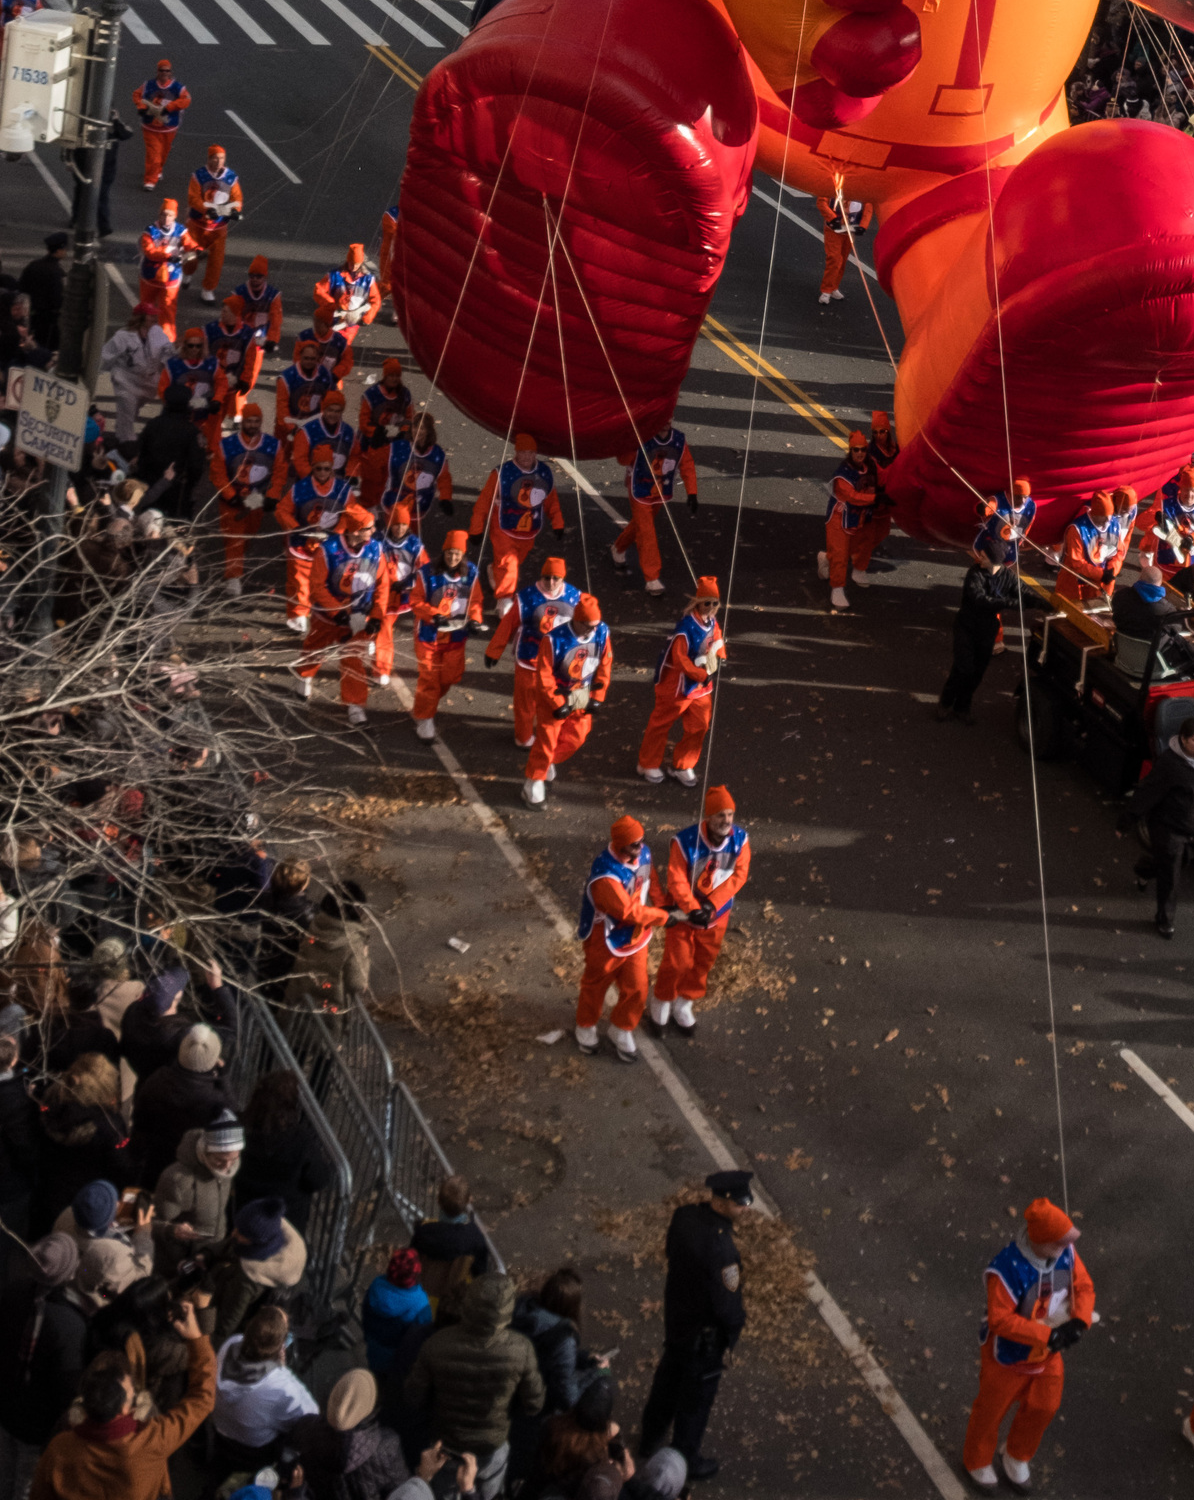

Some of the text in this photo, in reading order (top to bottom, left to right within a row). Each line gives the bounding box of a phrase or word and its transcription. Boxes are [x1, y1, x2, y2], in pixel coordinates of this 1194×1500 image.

[12, 65, 49, 85] 71538
[32, 376, 78, 406] NYPD
[19, 410, 81, 449] SECURITY
[21, 429, 74, 464] CAMERA
